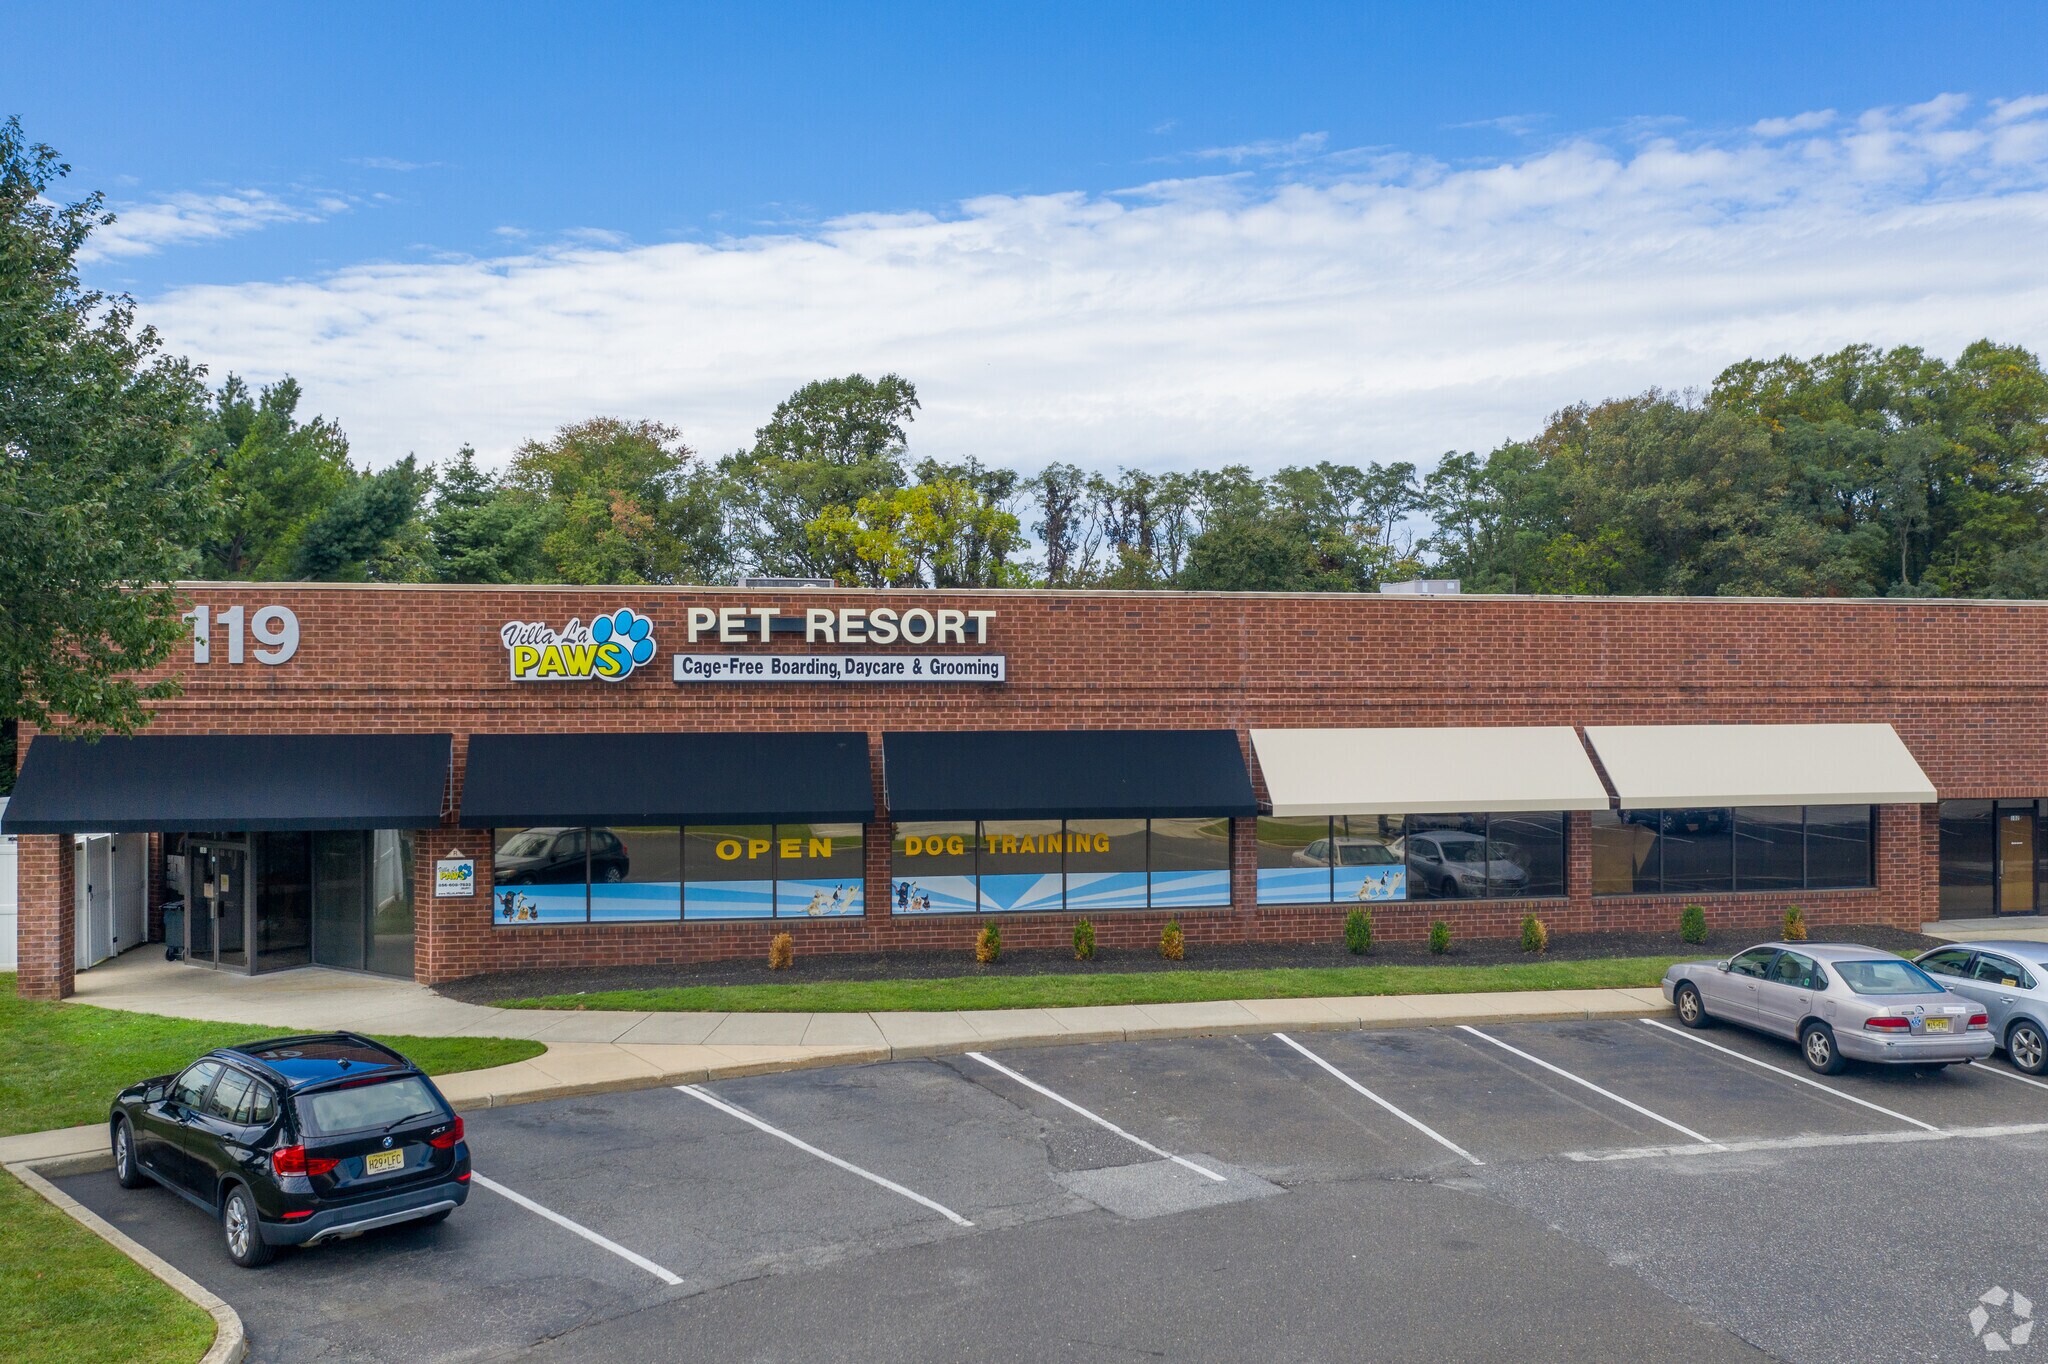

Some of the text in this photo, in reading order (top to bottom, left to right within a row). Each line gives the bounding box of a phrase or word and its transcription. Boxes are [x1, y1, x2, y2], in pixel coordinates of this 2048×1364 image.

[182, 606, 299, 665] 119
[503, 620, 588, 646] Villa La
[688, 608, 996, 644] PET RESORT
[514, 643, 623, 677] PAWS
[682, 657, 999, 679] Cage-Free Boarding, Daycare & Grooming
[715, 838, 832, 860] OPEN
[905, 833, 1110, 856] DOG TRAINING
[440, 872, 465, 880] PAWS
